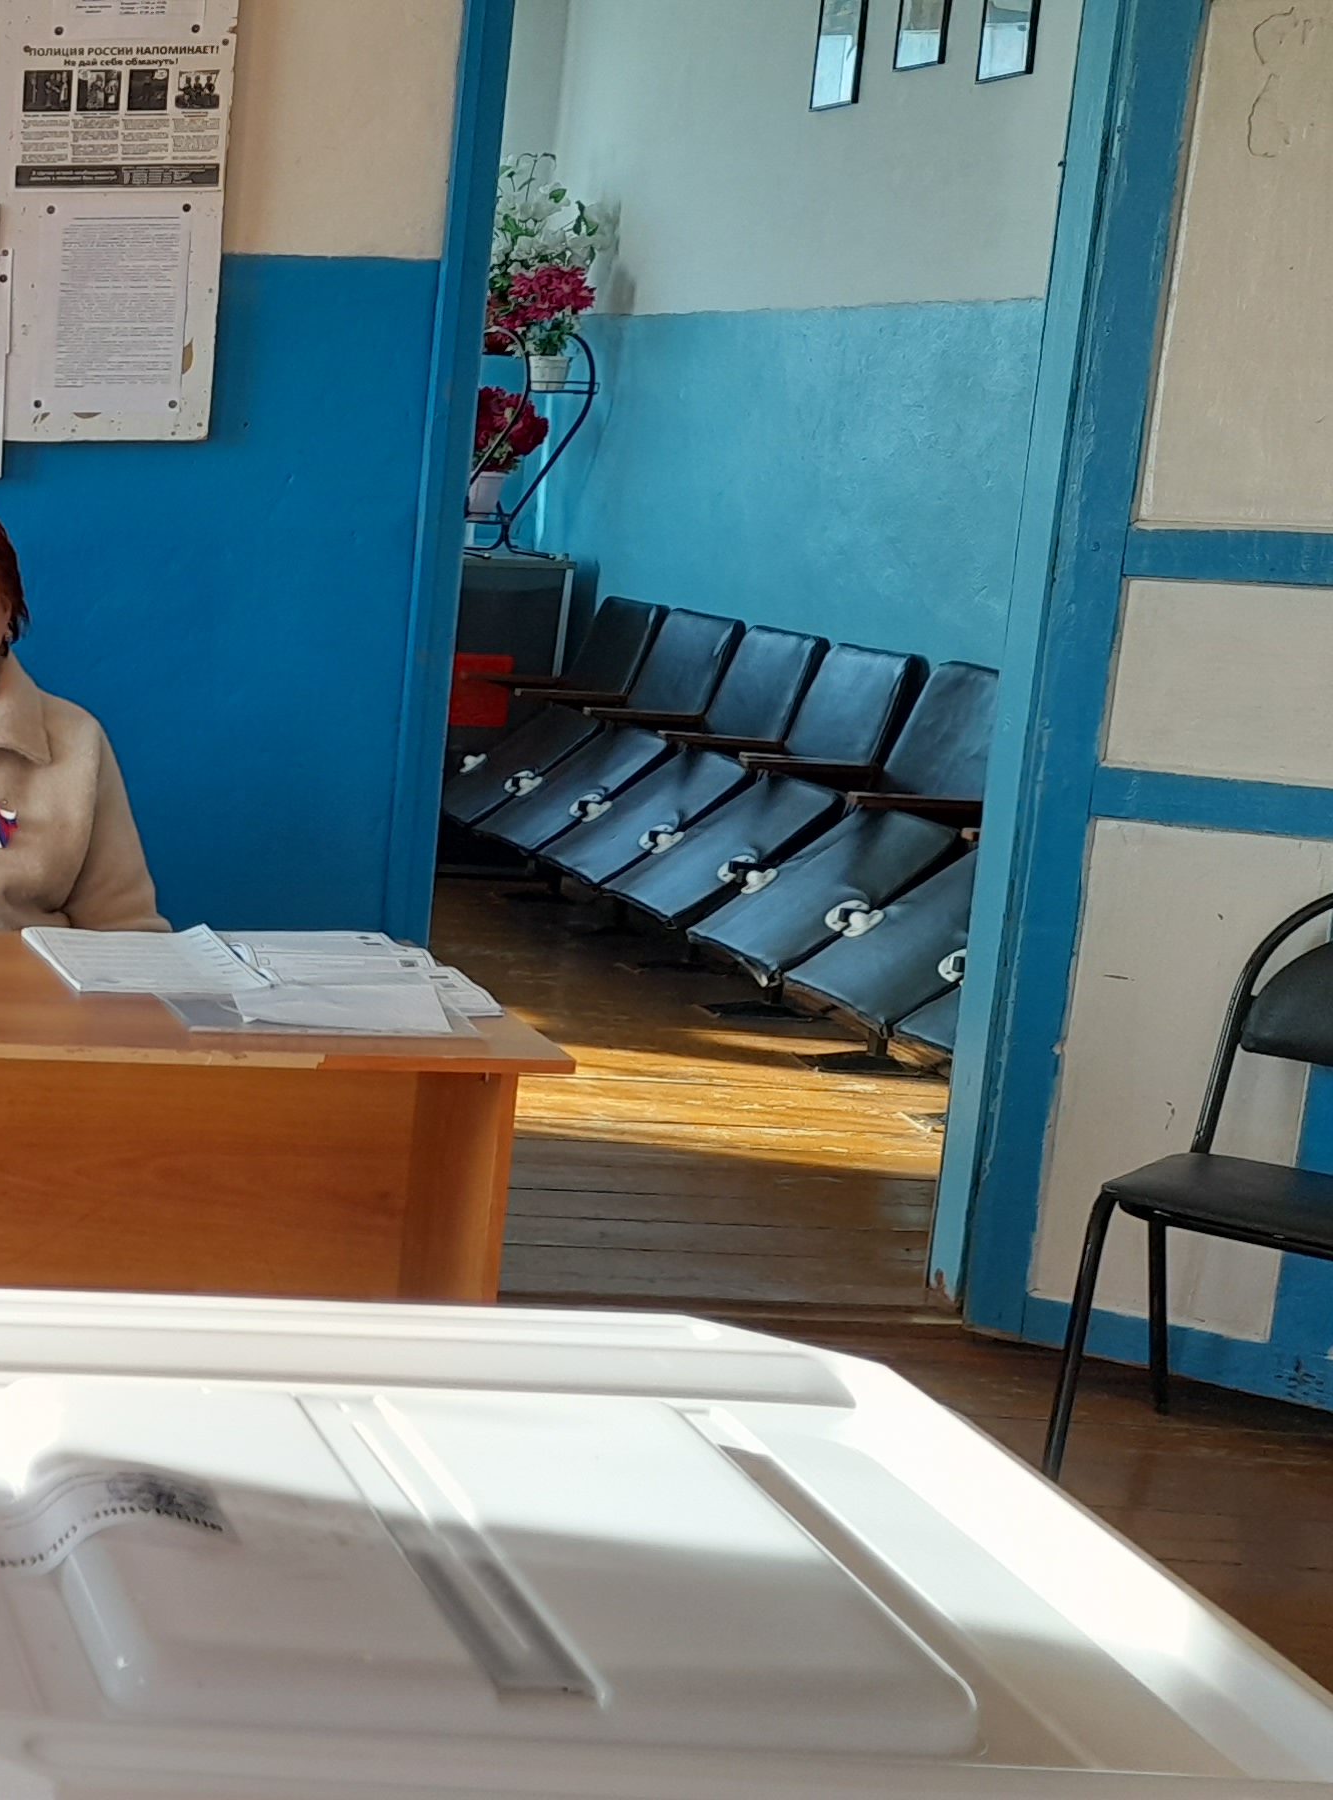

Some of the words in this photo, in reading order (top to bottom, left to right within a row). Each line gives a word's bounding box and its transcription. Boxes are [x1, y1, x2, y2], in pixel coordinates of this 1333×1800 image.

[29, 47, 84, 58] ПОЛИЦИЯ
[87, 46, 133, 56] РОССИИ
[136, 45, 219, 55] НАПОМИНАЕТ!
[64, 59, 76, 67] Не
[78, 58, 98, 68] дай
[125, 57, 179, 68] обмануть!
